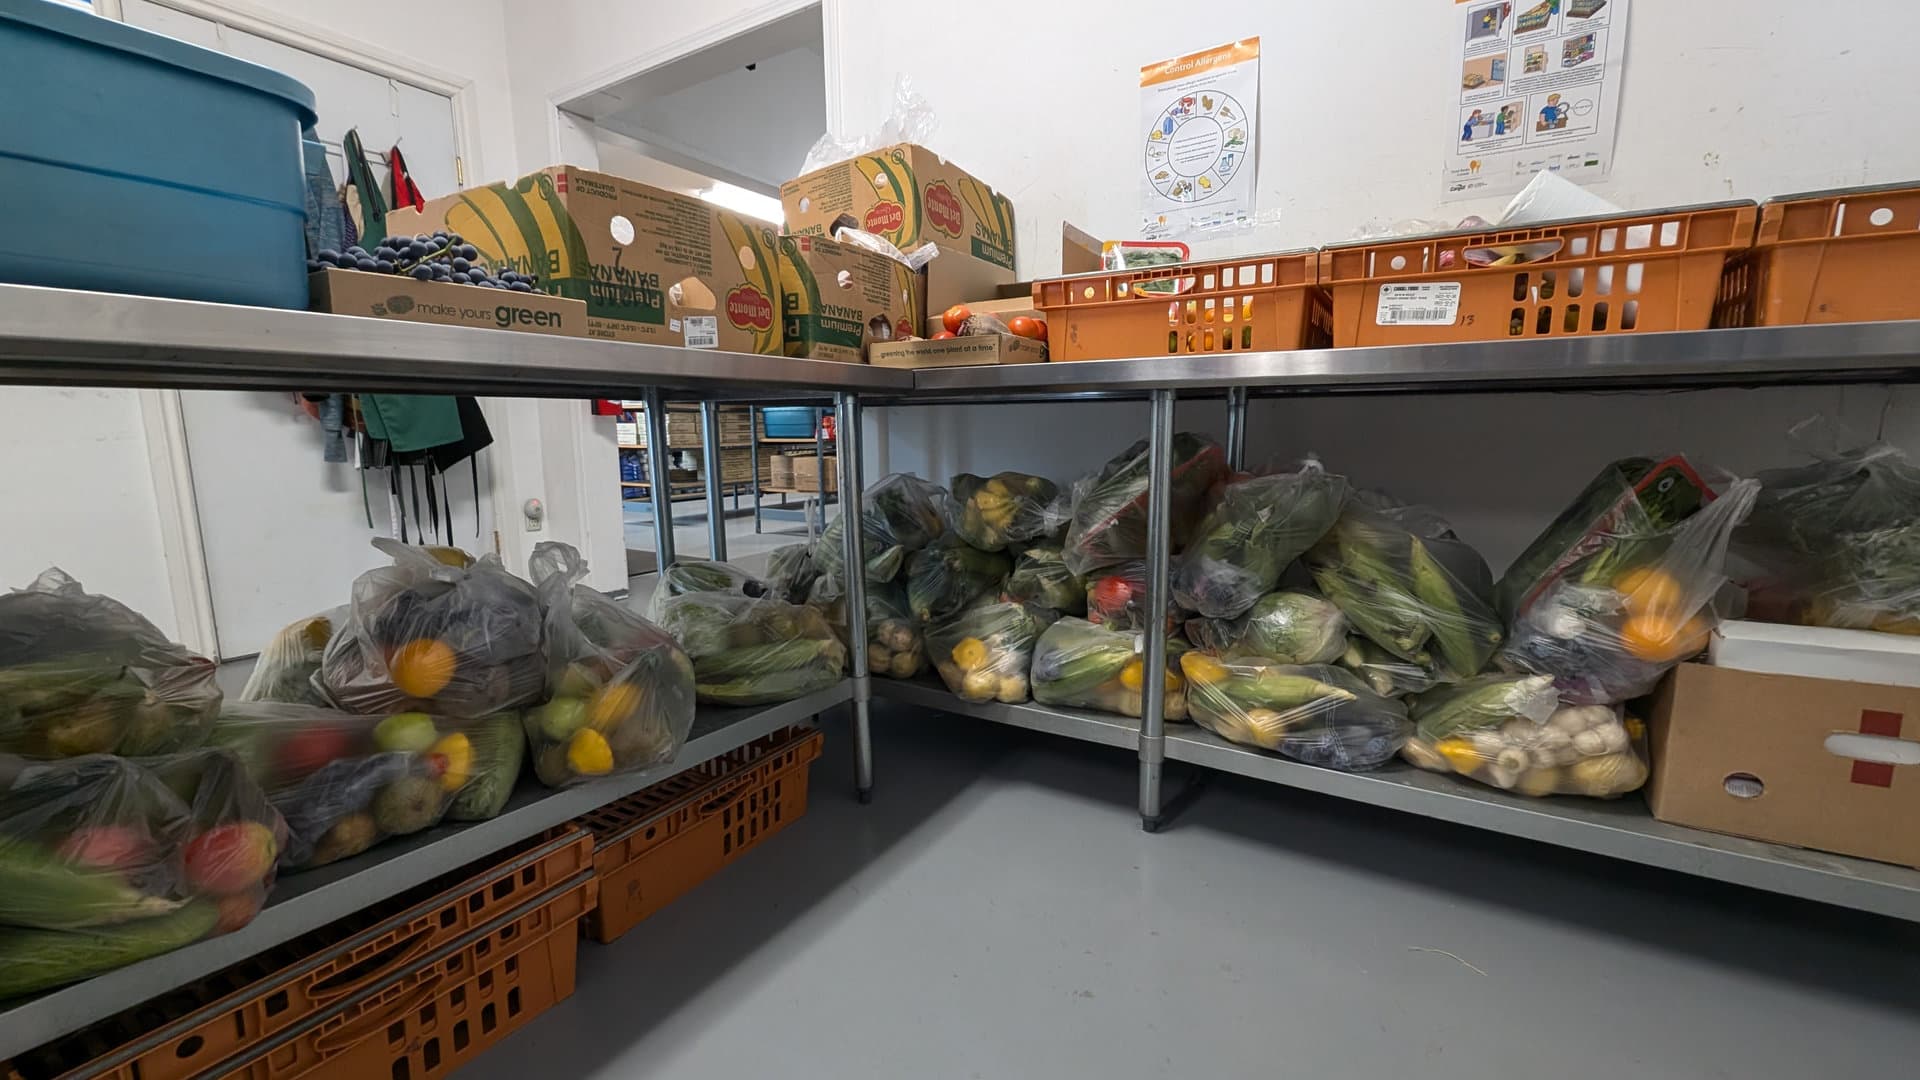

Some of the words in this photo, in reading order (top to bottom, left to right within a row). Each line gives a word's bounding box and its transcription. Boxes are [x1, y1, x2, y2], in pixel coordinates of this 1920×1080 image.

[1165, 59, 1194, 75] Control
[586, 188, 618, 201] PRODUCT
[927, 197, 950, 220] Monte
[866, 214, 889, 228] Monte
[889, 211, 901, 223] Del
[950, 210, 960, 225] Del
[981, 243, 1013, 269] Premium
[589, 283, 661, 308] Premium
[417, 303, 457, 317] make
[459, 307, 491, 321] yours
[495, 305, 562, 328] green
[729, 302, 757, 318] Monte
[758, 306, 771, 320] Del
[820, 318, 863, 337] Premium
